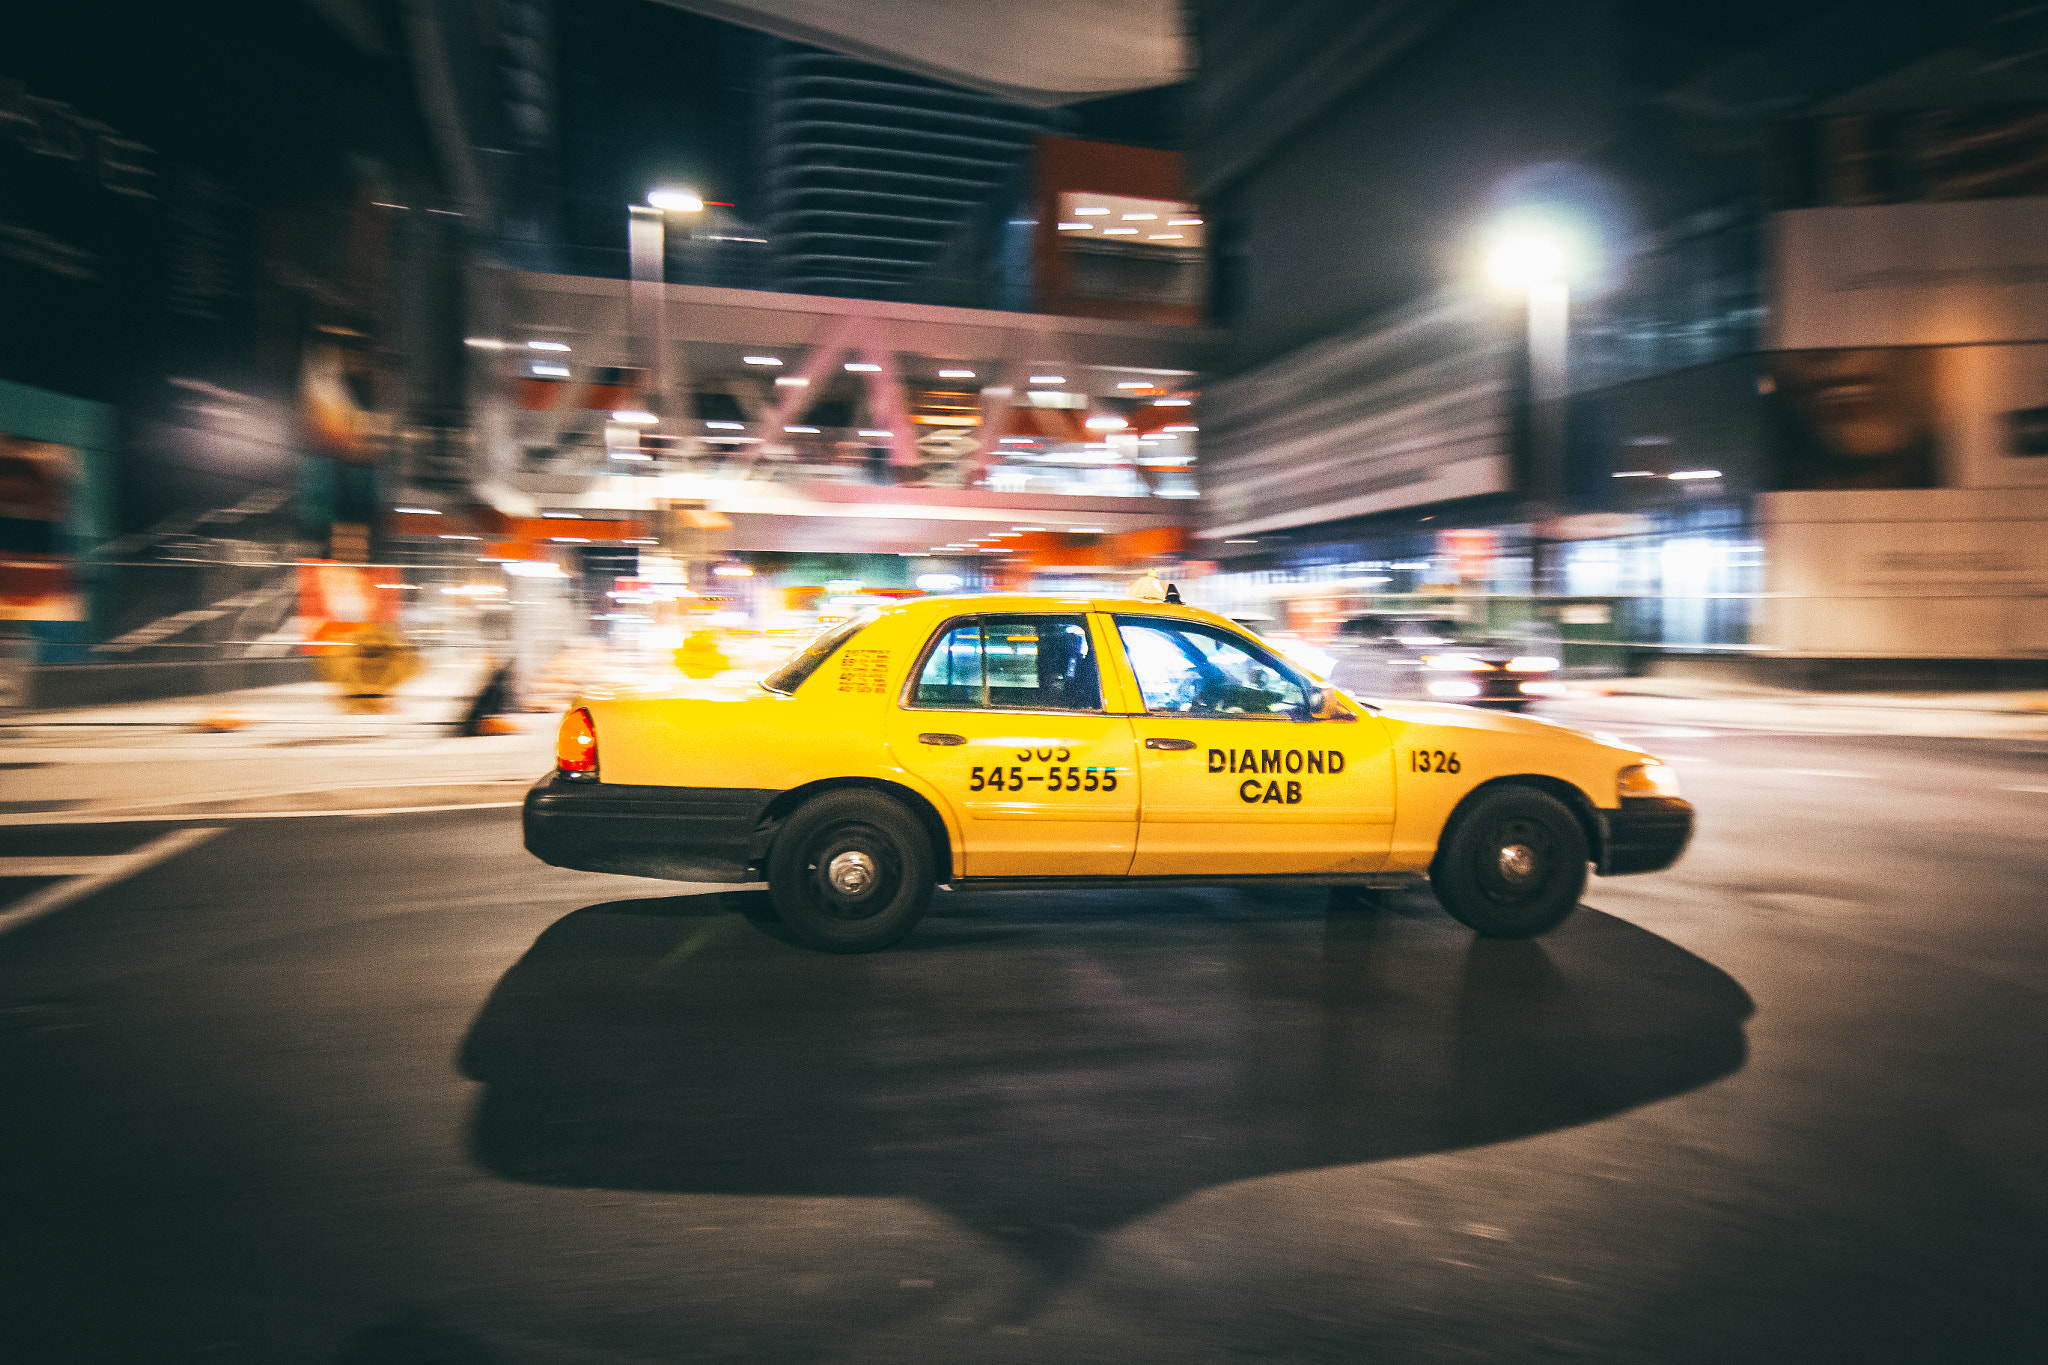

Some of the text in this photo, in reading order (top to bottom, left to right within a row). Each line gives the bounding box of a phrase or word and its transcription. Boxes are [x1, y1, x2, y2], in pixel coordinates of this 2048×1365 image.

[1207, 748, 1345, 774] DIAMOND
[1412, 750, 1461, 774] 1326
[970, 766, 1117, 791] 545-5555
[1239, 780, 1302, 804] CAB
